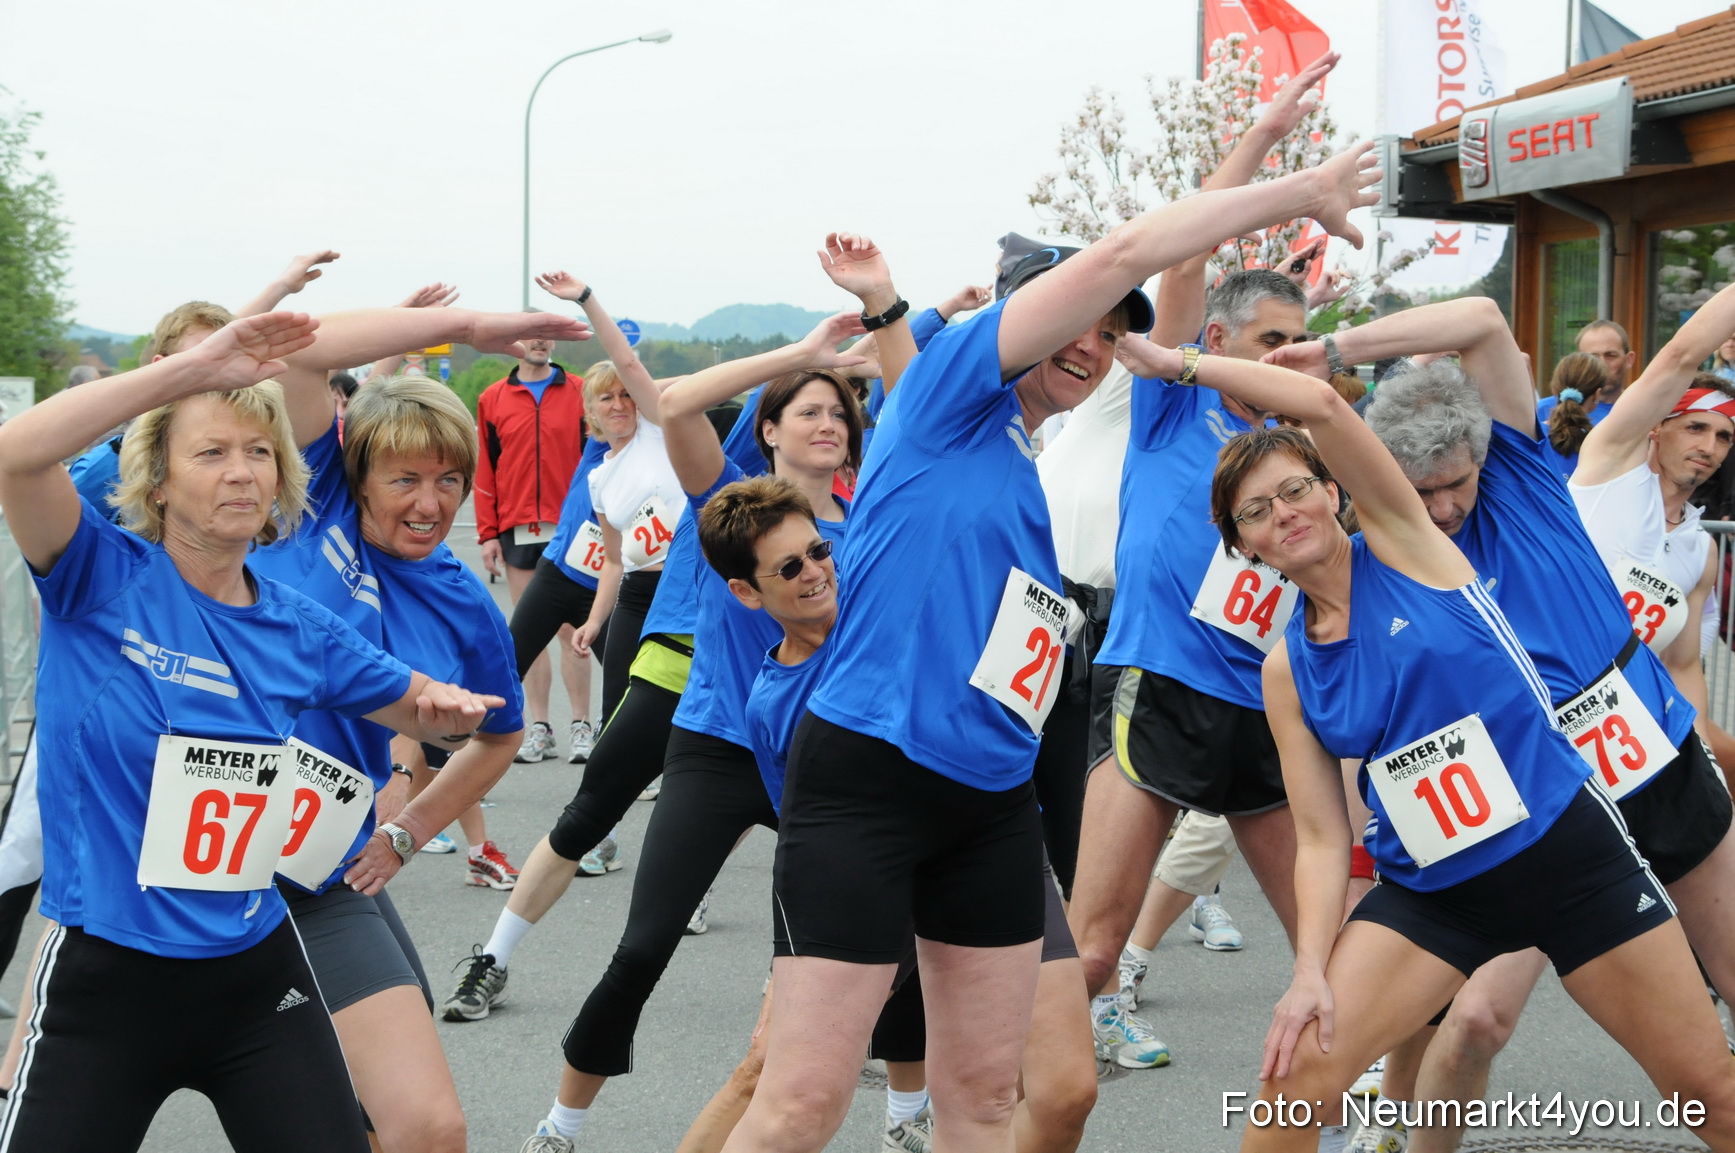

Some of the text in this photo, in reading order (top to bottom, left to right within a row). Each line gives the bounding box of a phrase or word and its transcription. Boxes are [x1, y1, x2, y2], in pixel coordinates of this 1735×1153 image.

[1435, 0, 1467, 123] OTORS
[1508, 112, 1599, 162] SEAT
[588, 526, 603, 537] MEY
[634, 515, 673, 557] 24
[1627, 575, 1664, 600] WERBUNG
[1629, 567, 1667, 592] MEYER
[1023, 597, 1062, 632] WERBUNG
[1026, 583, 1066, 621] MEYER
[1223, 569, 1283, 639] 64
[1010, 627, 1061, 712] 21
[184, 746, 255, 769] MEYER
[1385, 740, 1439, 774] MEYER
[1390, 752, 1444, 783] WERBUNG
[1574, 714, 1647, 787] 73
[184, 764, 253, 782] WERBUNG
[1413, 762, 1491, 840] 10
[183, 789, 268, 875] 67
[276, 996, 309, 1011] adidas
